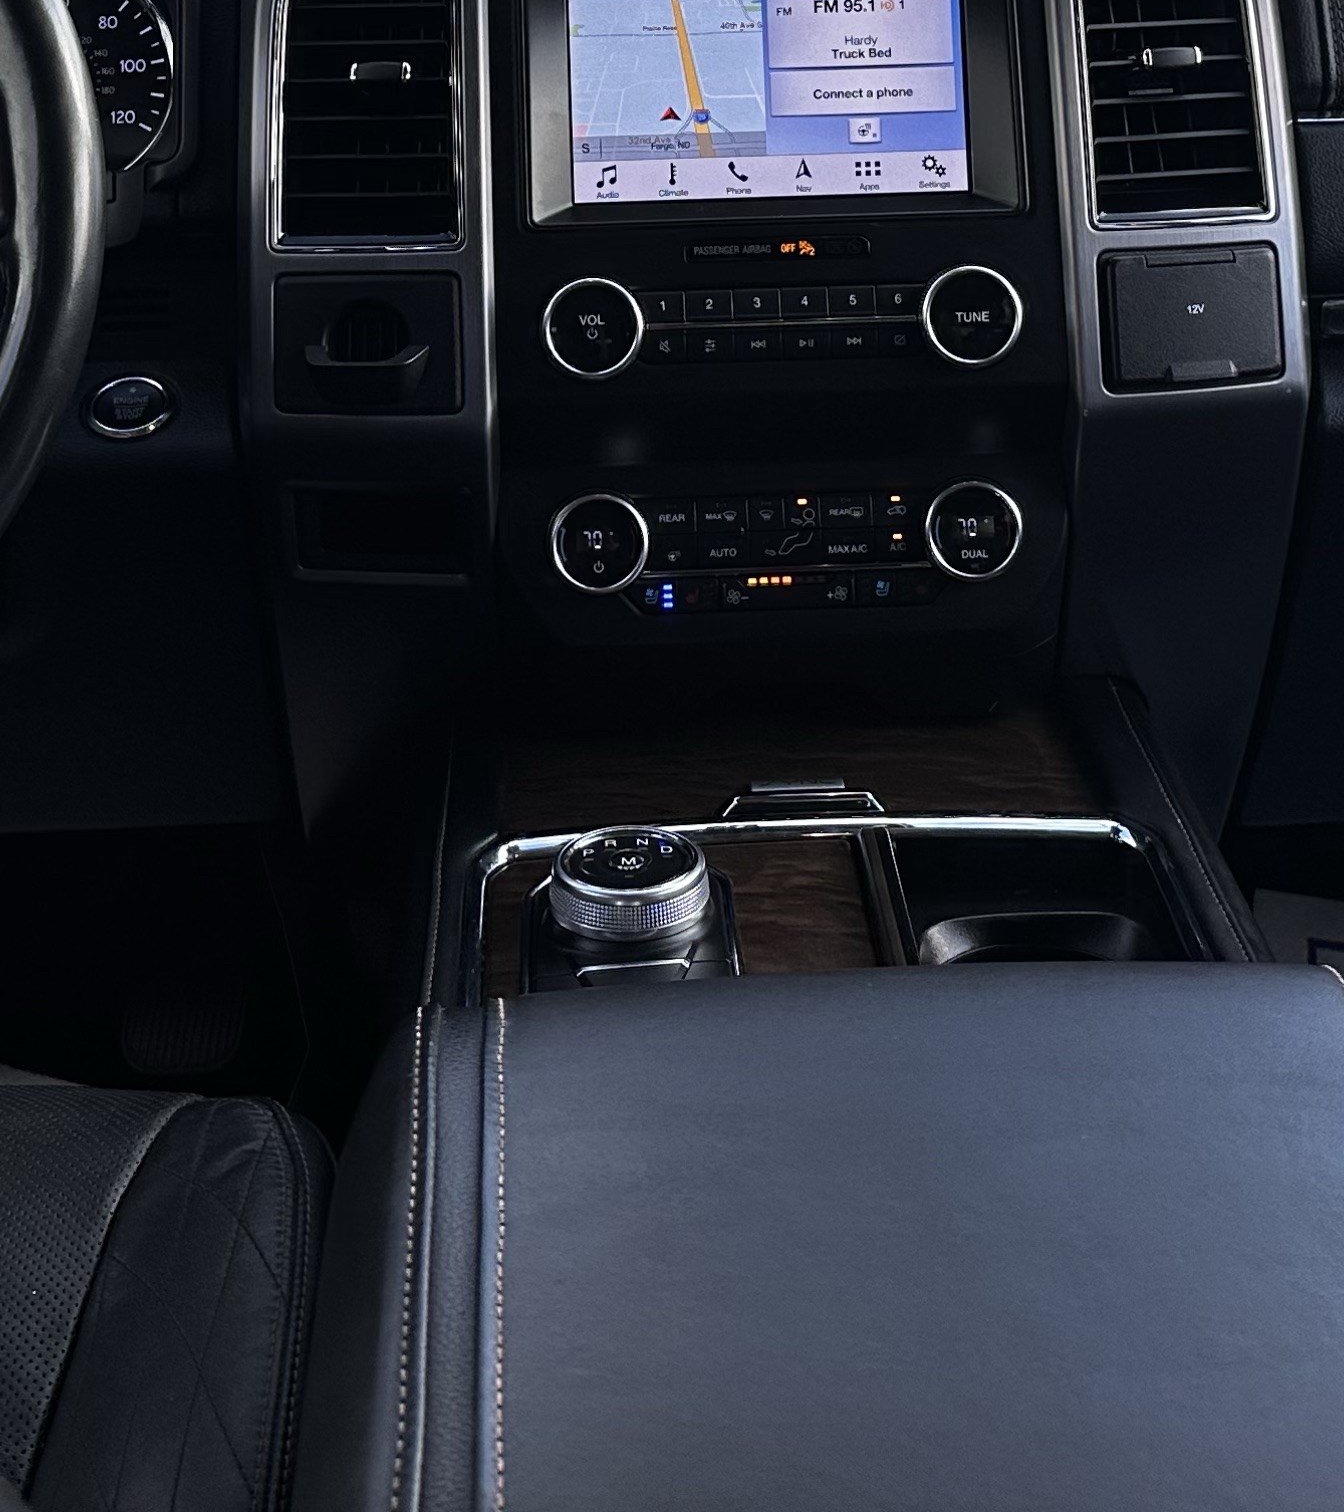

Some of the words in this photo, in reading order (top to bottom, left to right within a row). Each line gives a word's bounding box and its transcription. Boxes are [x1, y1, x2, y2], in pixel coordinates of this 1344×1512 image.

[776, 7, 792, 16] FM
[813, 0, 839, 14] FM
[898, 0, 905, 10] 1
[98, 16, 118, 29] 80
[844, 35, 878, 47] Hardy
[831, 48, 866, 60] Truck
[868, 47, 892, 58] Bed
[120, 58, 147, 73] 100
[813, 88, 864, 100] Connect
[866, 90, 874, 98] a
[876, 87, 914, 100] phone
[110, 110, 136, 125] 120
[581, 143, 590, 154] S
[726, 186, 752, 195] Phone
[796, 184, 812, 193] Nav
[859, 182, 880, 192] Apps
[918, 180, 951, 190] Settings
[596, 190, 620, 199] Audio
[658, 188, 689, 197] Climate
[693, 245, 740, 256] PASSENGER
[742, 244, 771, 254] AIRBAG
[780, 243, 796, 253] OFF
[705, 299, 713, 309] 2
[753, 297, 761, 308] 3
[800, 296, 809, 306] 4
[849, 294, 857, 305] 5
[894, 293, 903, 304] 6
[659, 300, 666, 311] 1
[1186, 303, 1205, 314] 12V
[578, 314, 606, 326] VOL
[955, 311, 990, 323] TUNE
[658, 513, 686, 523] REAR
[709, 548, 737, 558] AUTO
[828, 544, 849, 554] MAX
[960, 549, 988, 559] DUAL
[583, 848, 594, 857] P
[604, 839, 617, 848] R
[636, 837, 649, 846] N
[660, 845, 673, 854] D
[621, 856, 637, 866] M
